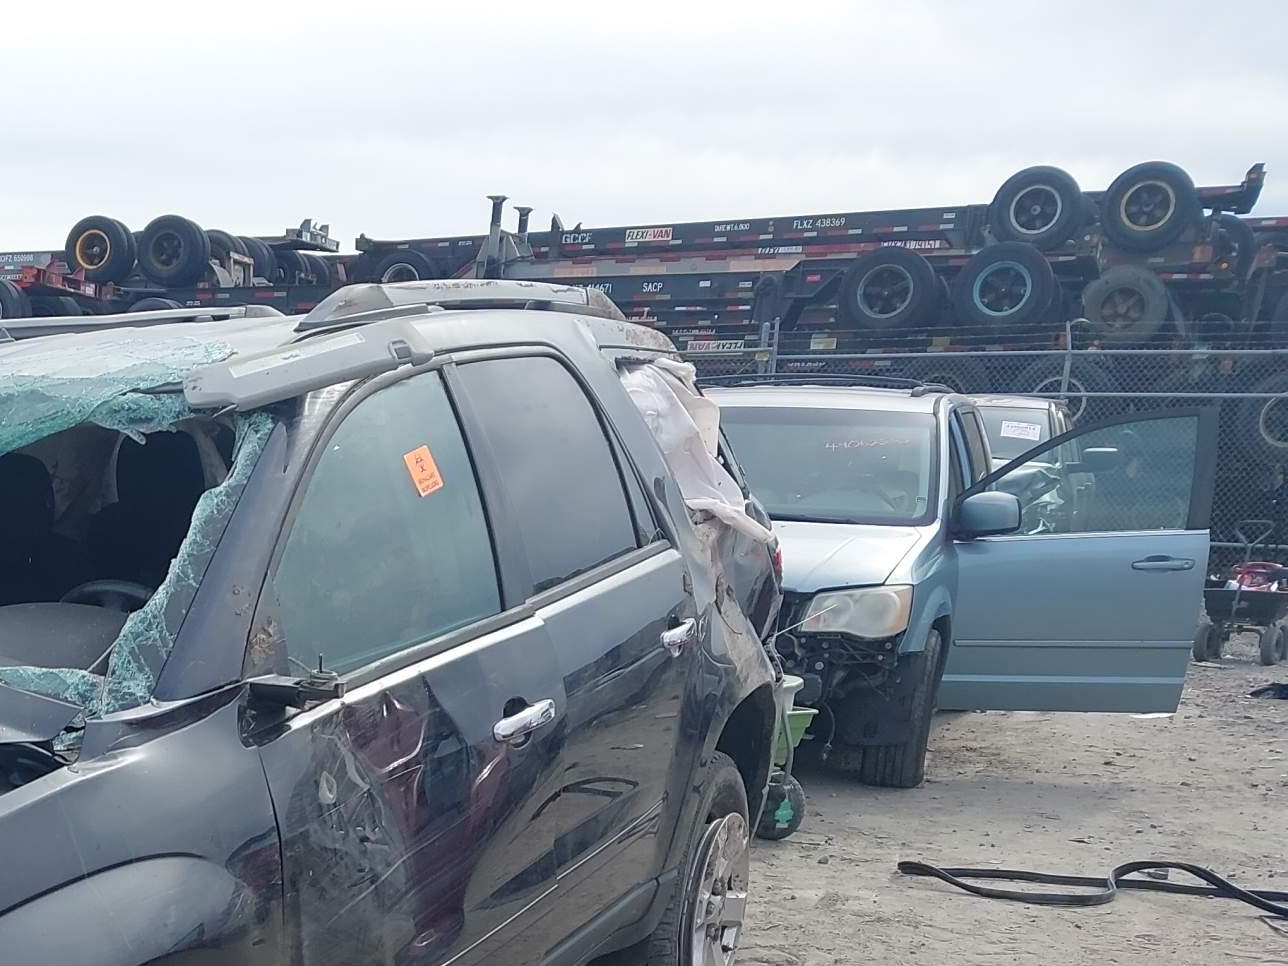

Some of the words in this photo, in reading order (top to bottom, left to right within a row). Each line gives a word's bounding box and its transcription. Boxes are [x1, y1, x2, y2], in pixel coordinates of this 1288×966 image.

[815, 217, 845, 228] 438369
[626, 229, 672, 241] FLEXI-VAN
[642, 281, 663, 293] SACP
